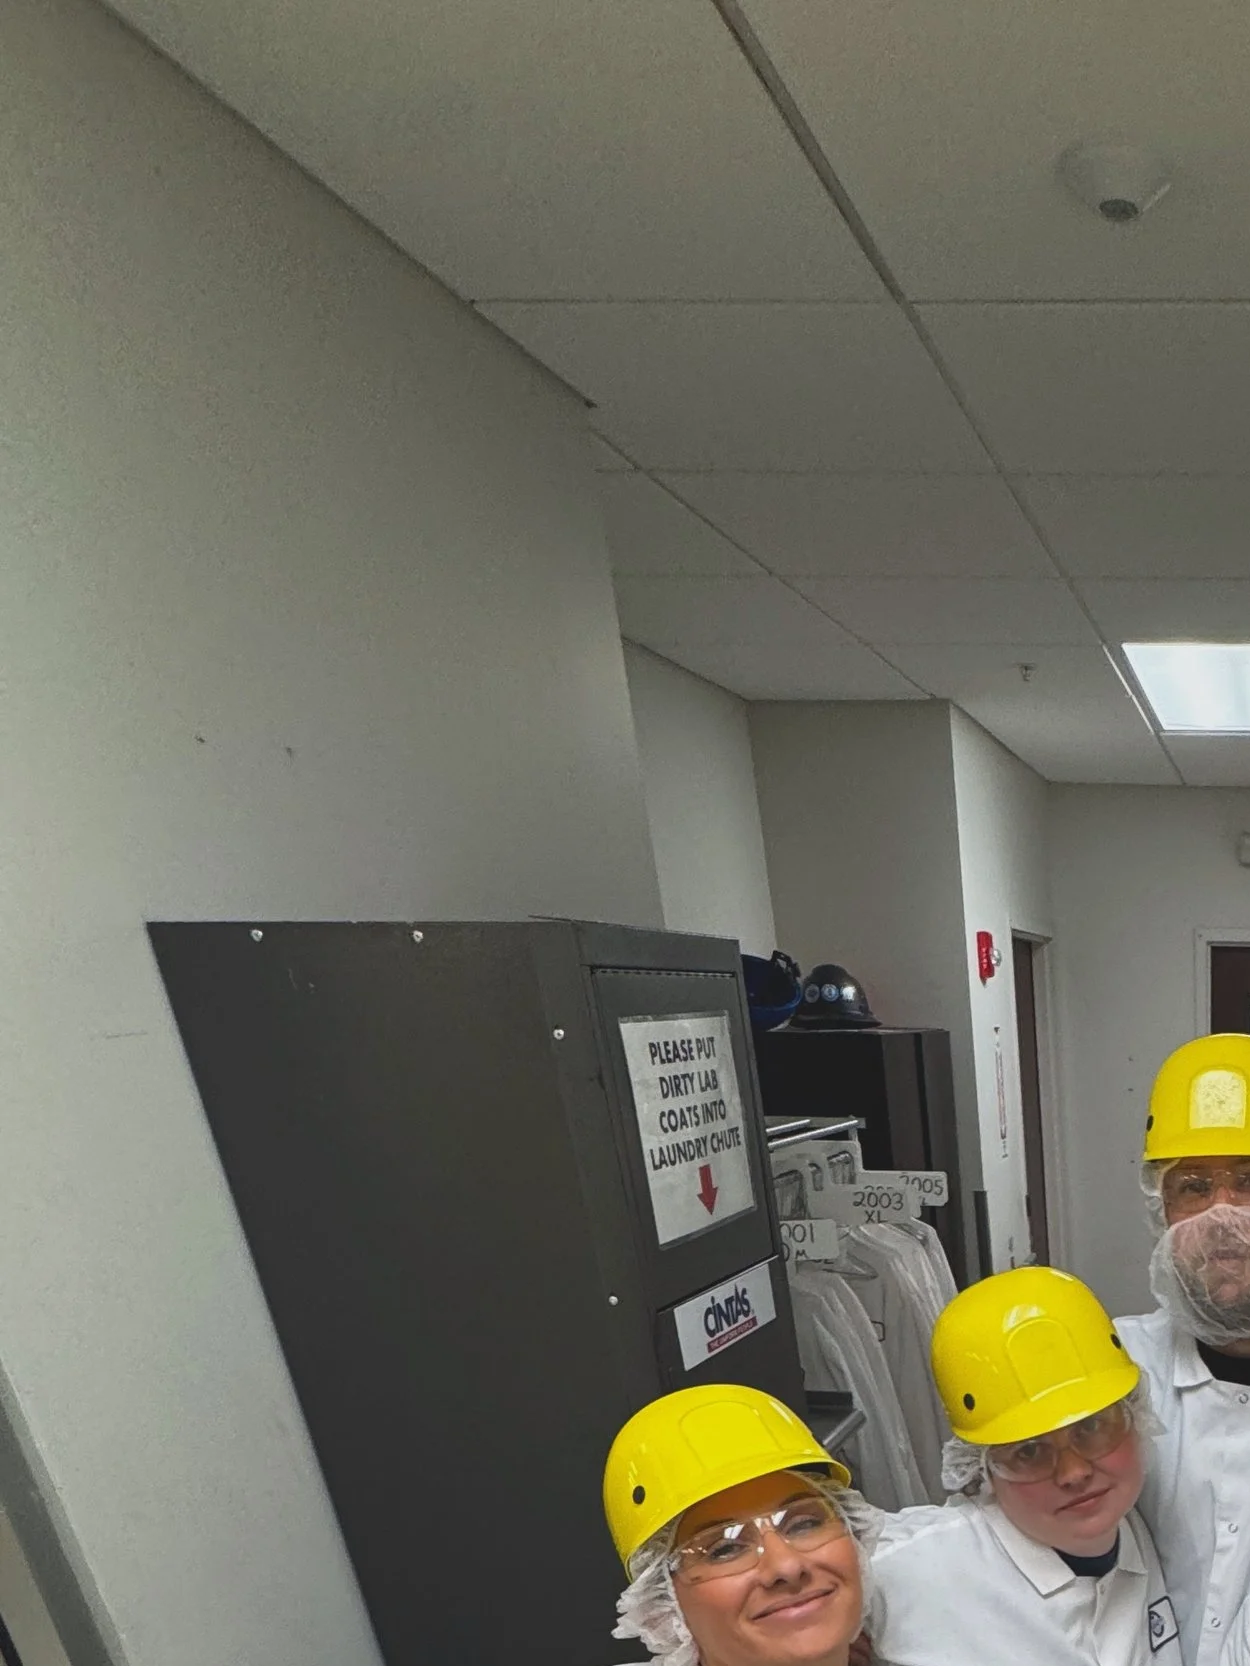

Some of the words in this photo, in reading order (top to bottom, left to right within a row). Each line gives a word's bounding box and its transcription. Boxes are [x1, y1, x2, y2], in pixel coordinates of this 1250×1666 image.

[648, 1039, 695, 1065] PLEASE
[695, 1037, 716, 1059] PUT
[659, 1072, 695, 1099] DIRTY
[698, 1069, 718, 1093] LAB
[659, 1105, 700, 1133] COATS
[701, 1099, 726, 1124] INTO
[650, 1135, 708, 1171] LAUNDRY
[710, 1126, 741, 1153] CHUTE
[852, 1191, 904, 1211] 2003
[864, 1210, 888, 1223] XL
[780, 1222, 815, 1243] 001
[704, 1283, 751, 1338] CINTAS
